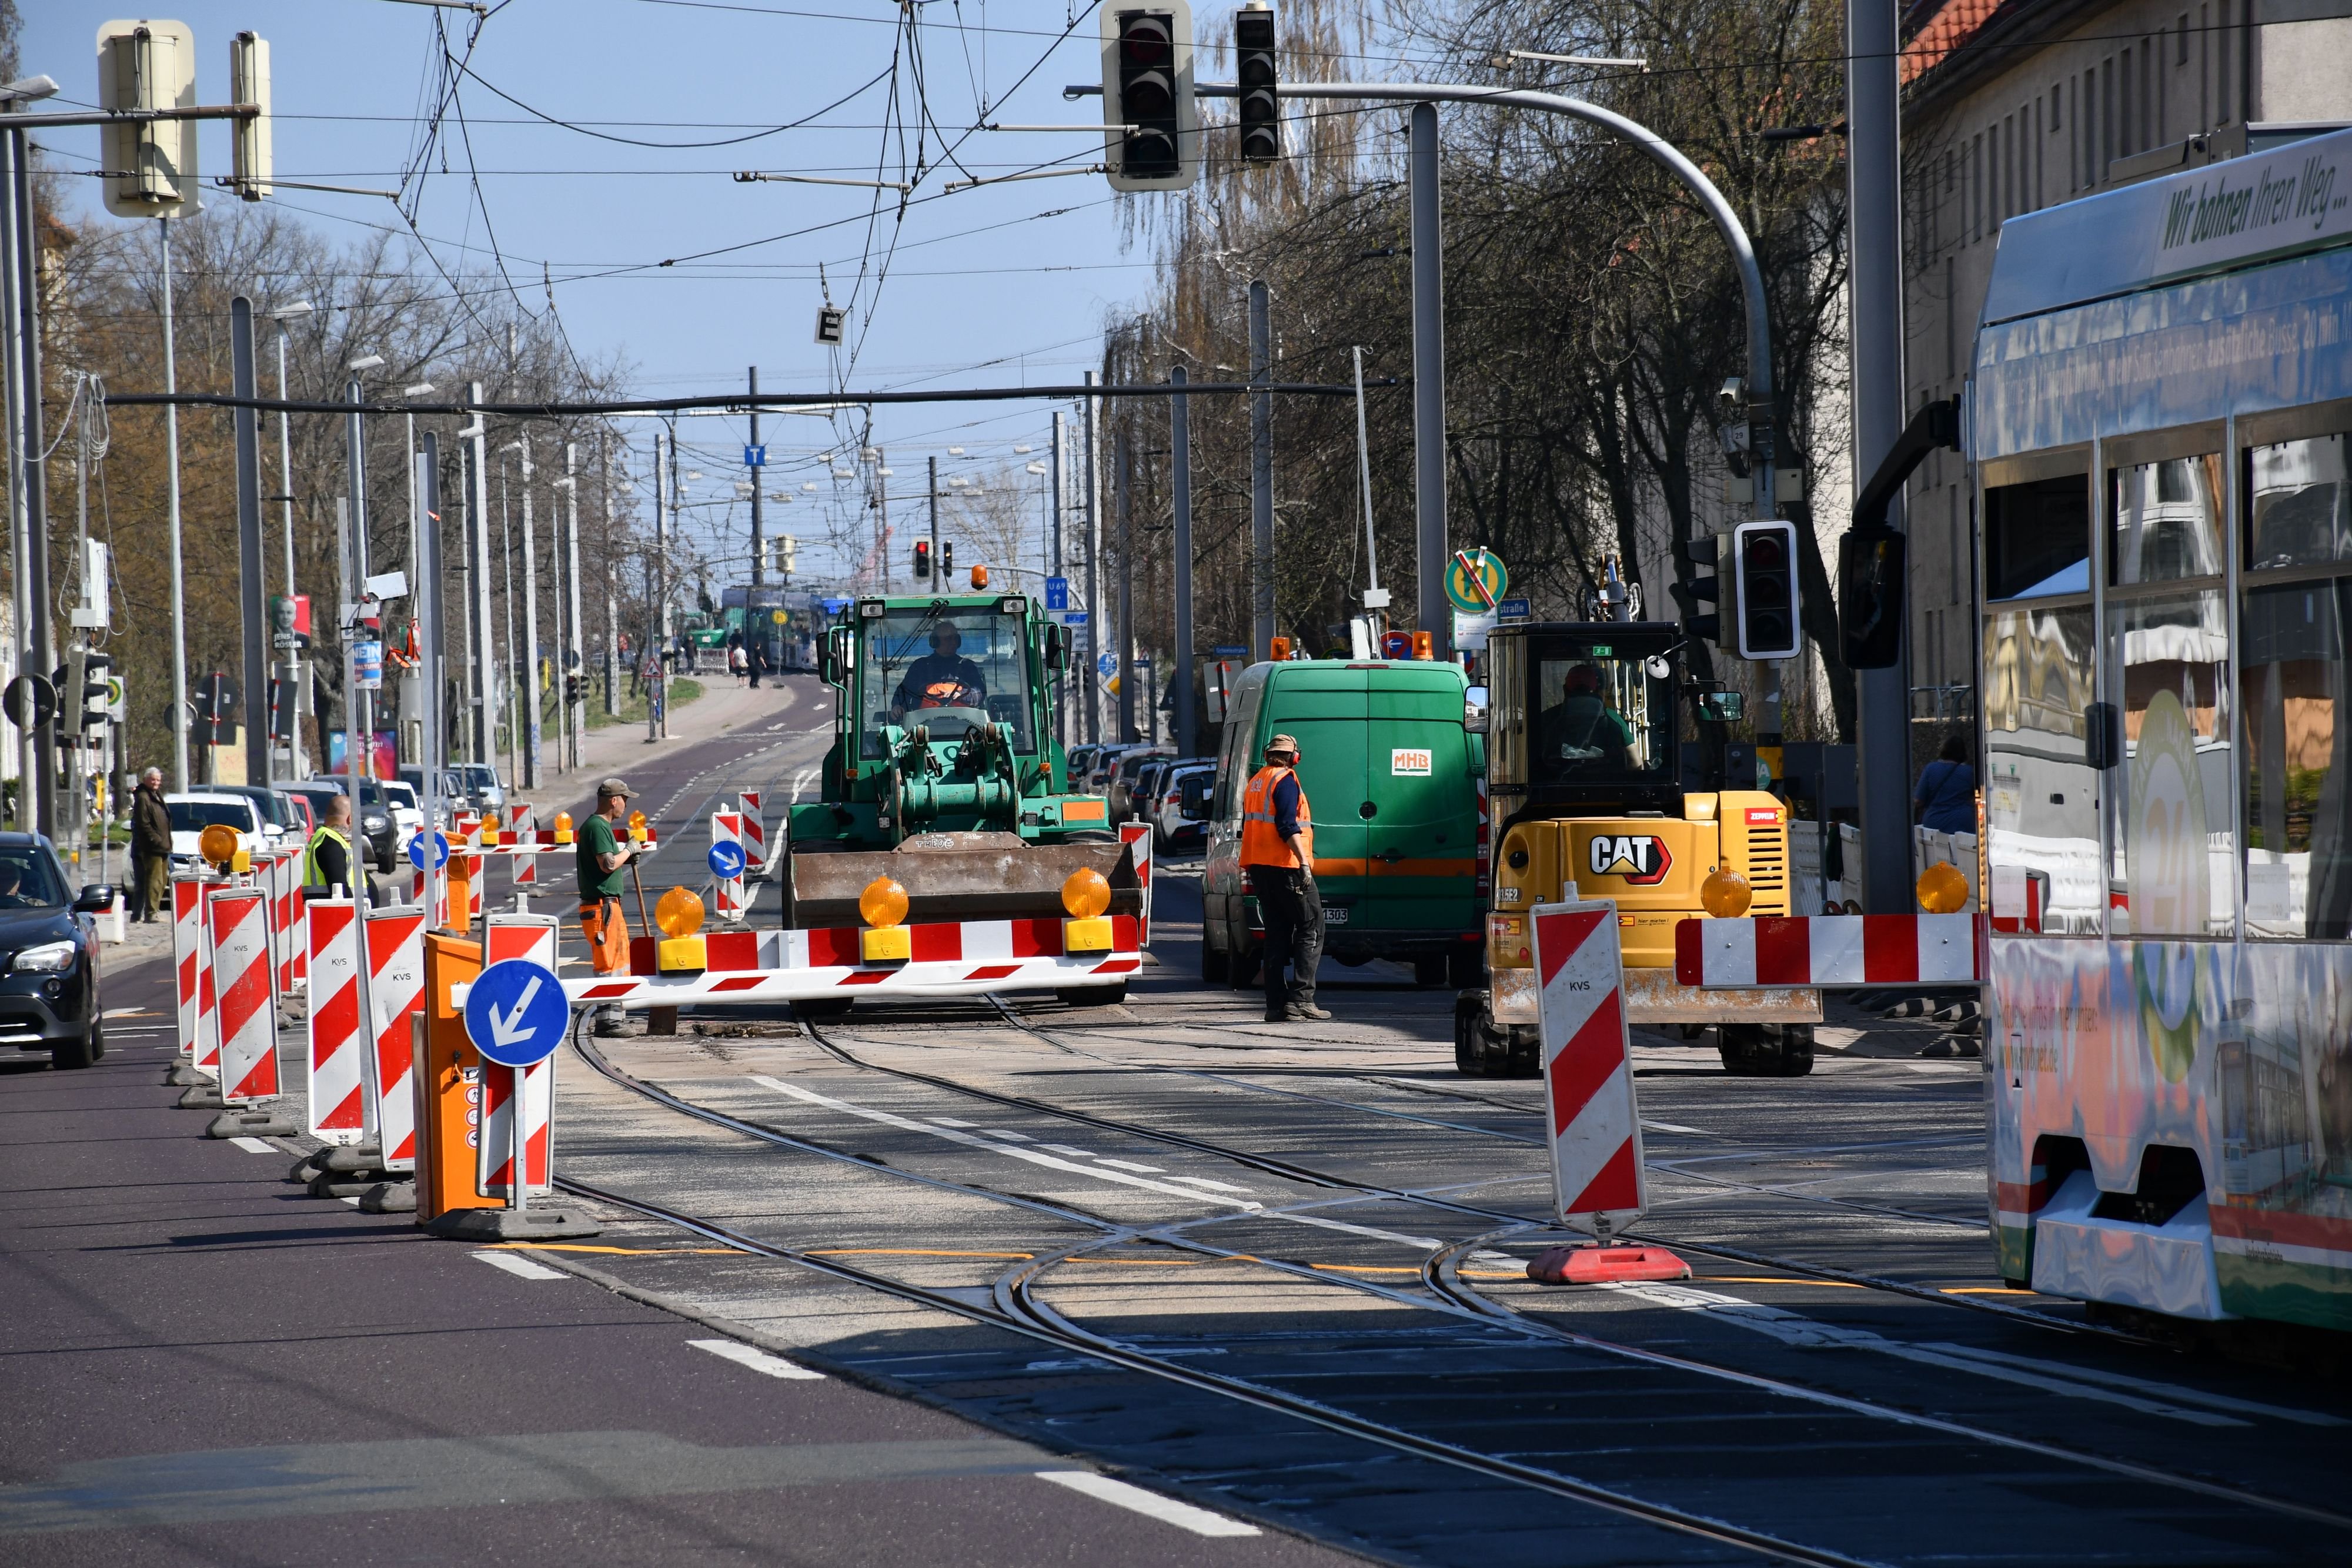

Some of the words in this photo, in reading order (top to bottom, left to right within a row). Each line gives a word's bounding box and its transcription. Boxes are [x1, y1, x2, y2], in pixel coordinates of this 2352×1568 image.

[2163, 185, 2196, 250] Wir
[2190, 176, 2254, 245] bahnen
[2250, 164, 2296, 229] Ihren
[2296, 154, 2336, 230] Weg
[819, 312, 841, 342] E
[2303, 309, 2317, 349] 20
[750, 449, 760, 463] T
[273, 634, 292, 642] JENS
[275, 640, 302, 648] RÖSLER
[1394, 753, 1429, 768] MHB
[915, 838, 944, 848] THEO
[1591, 836, 1652, 874] CAT
[1323, 909, 1347, 920] 1303
[393, 973, 412, 981] KVS
[1570, 981, 1590, 992] KVS
